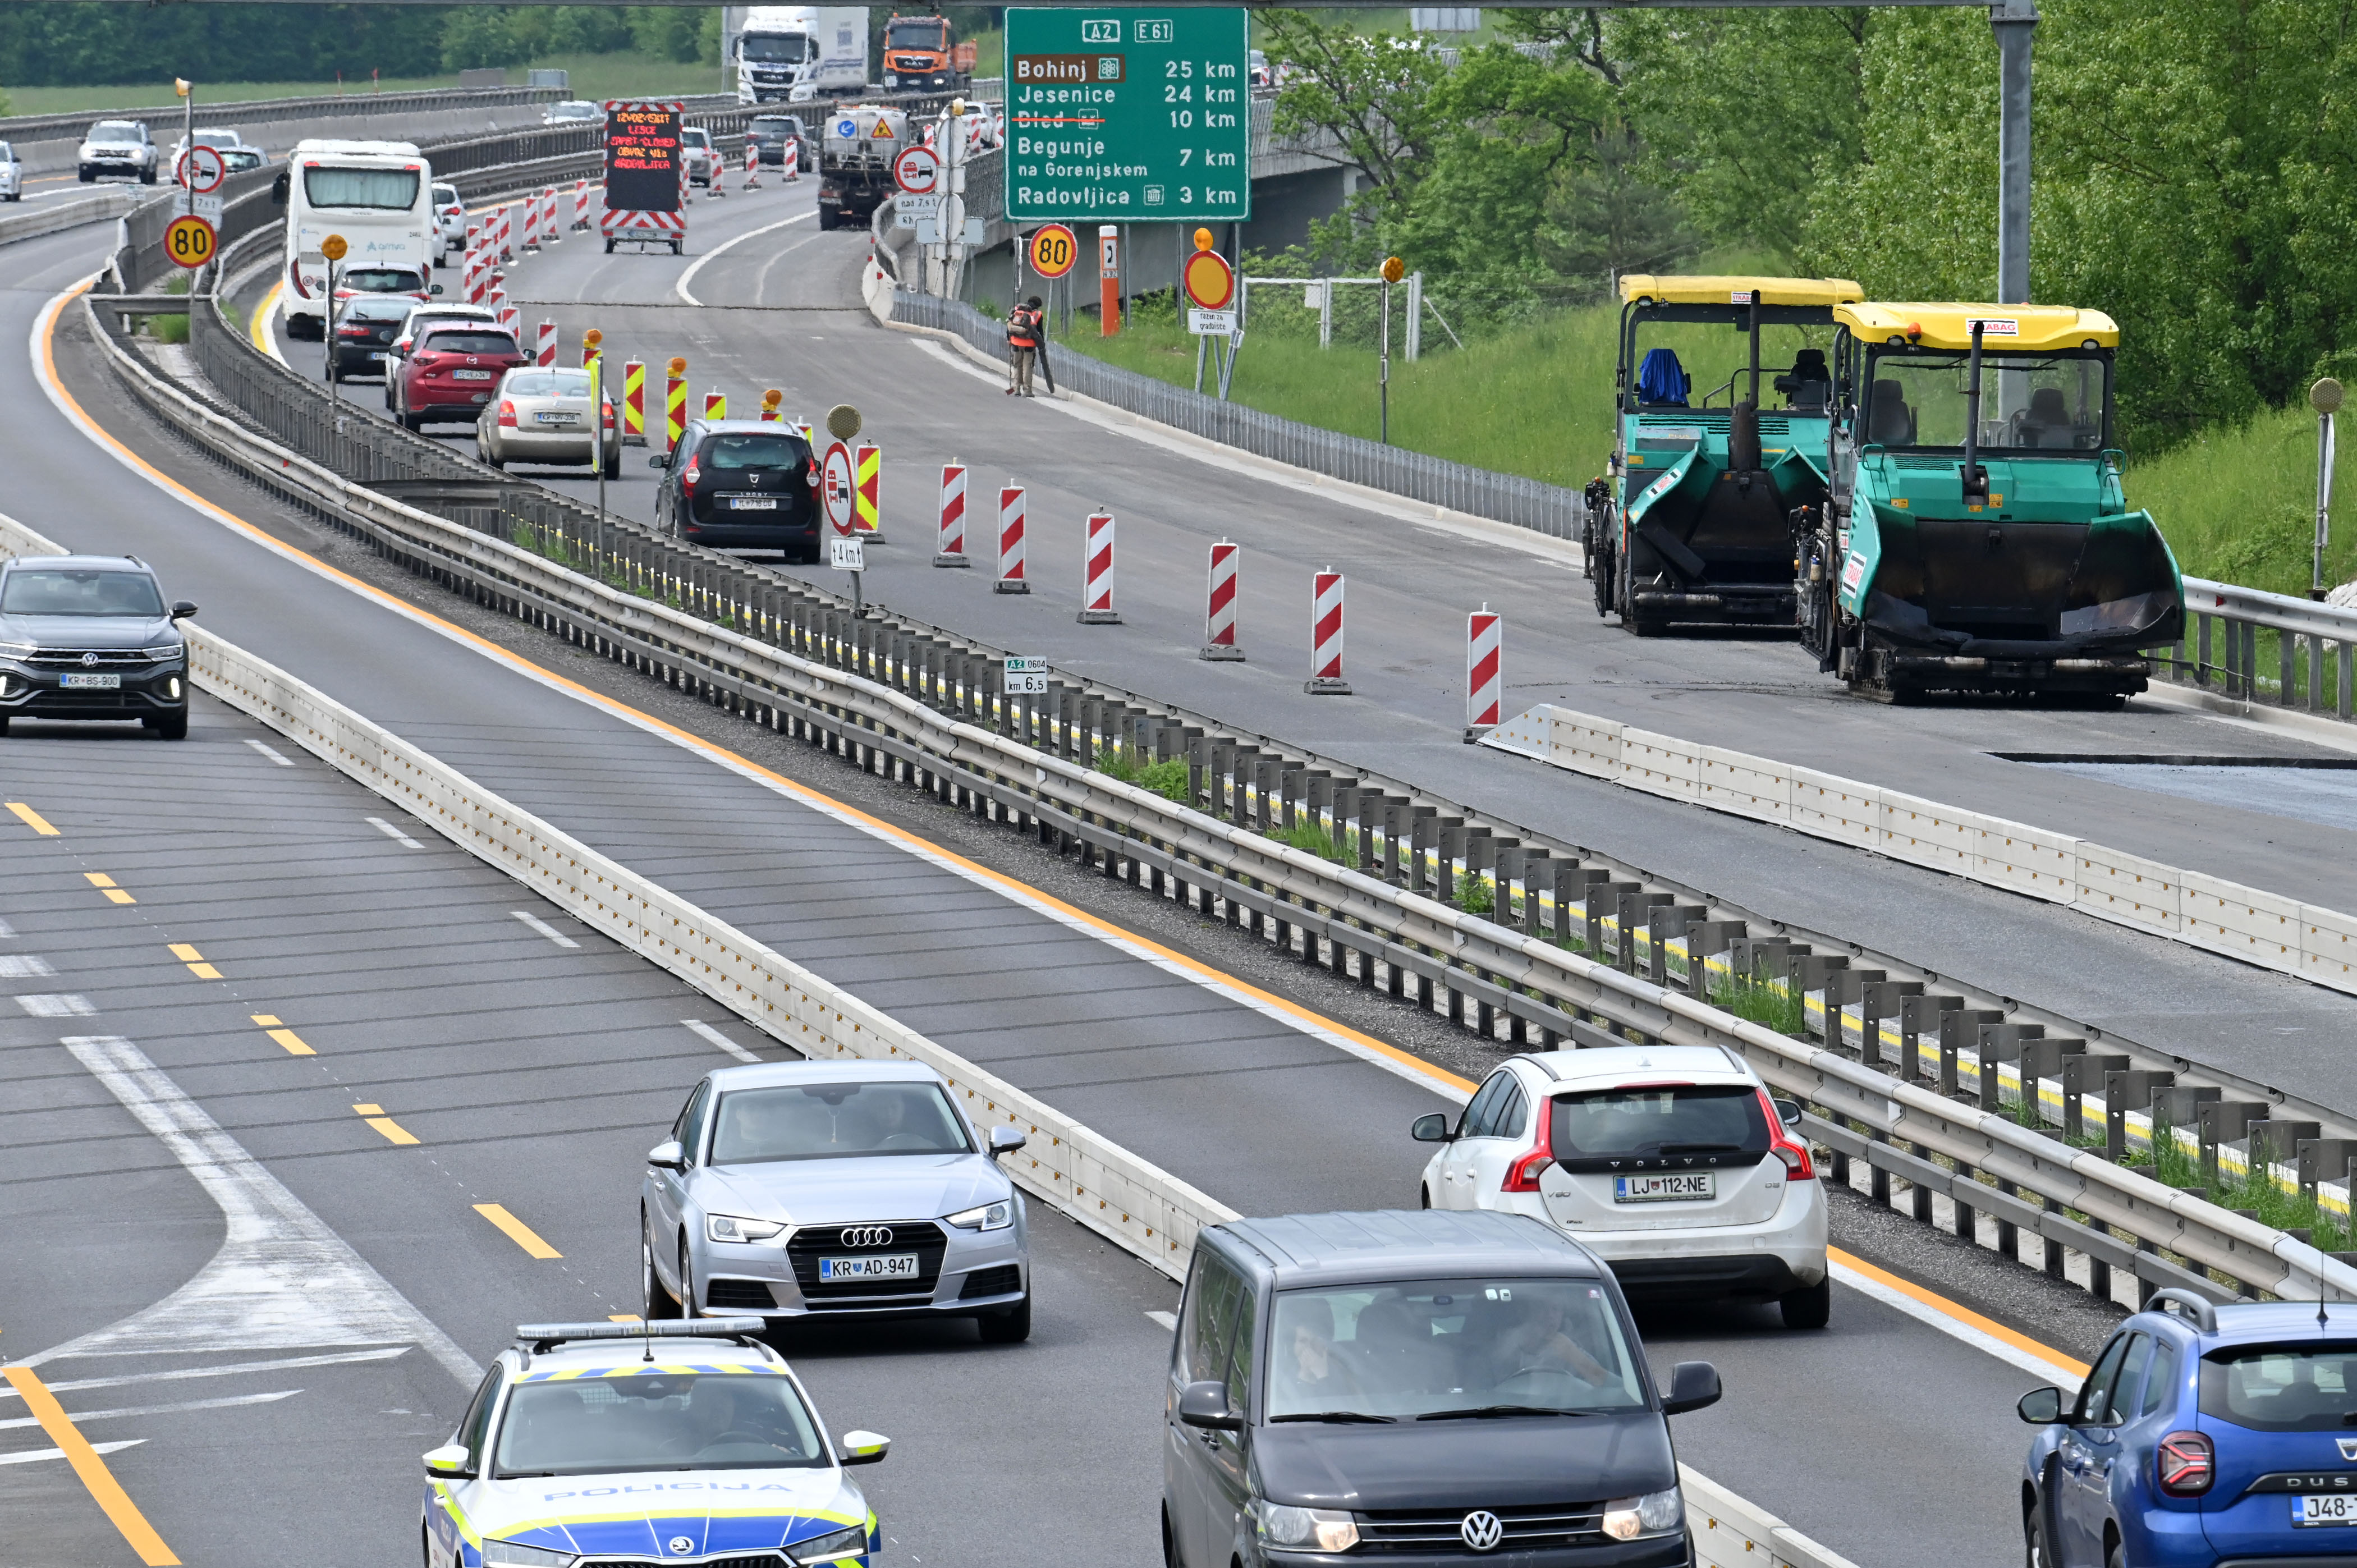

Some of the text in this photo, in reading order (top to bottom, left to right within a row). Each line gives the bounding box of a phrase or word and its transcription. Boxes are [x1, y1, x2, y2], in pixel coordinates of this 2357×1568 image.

[1090, 24, 1112, 39] A2
[1139, 23, 1168, 39] E 61
[1017, 60, 1086, 82] Bohinj
[1165, 61, 1235, 78] 25 km
[1018, 85, 1116, 103] Jesenice
[1164, 85, 1235, 103] 24 km
[1017, 111, 1065, 129] Bled
[1170, 110, 1235, 128] 10 km
[627, 125, 657, 135] LESCE
[1017, 137, 1105, 158] Begunje
[1180, 149, 1235, 167] 7 km
[1018, 162, 1148, 181] na Gorenjskem
[901, 198, 914, 207] nad
[1017, 186, 1130, 208] Radovljica
[1180, 186, 1236, 204] 3 km
[175, 228, 207, 255] 80
[1039, 237, 1067, 265] 80
[838, 544, 856, 563] 4 km
[1010, 660, 1045, 668] A2 0604
[68, 676, 118, 686] KR BS-900
[1008, 676, 1043, 691] km 6,5
[1609, 1156, 1717, 1168] VOLVO
[1632, 1177, 1707, 1195] LJ 112-NE
[832, 1258, 914, 1276] KR AD-947
[544, 1482, 792, 1502] POLICIJA
[2308, 1497, 2357, 1517] J48-
